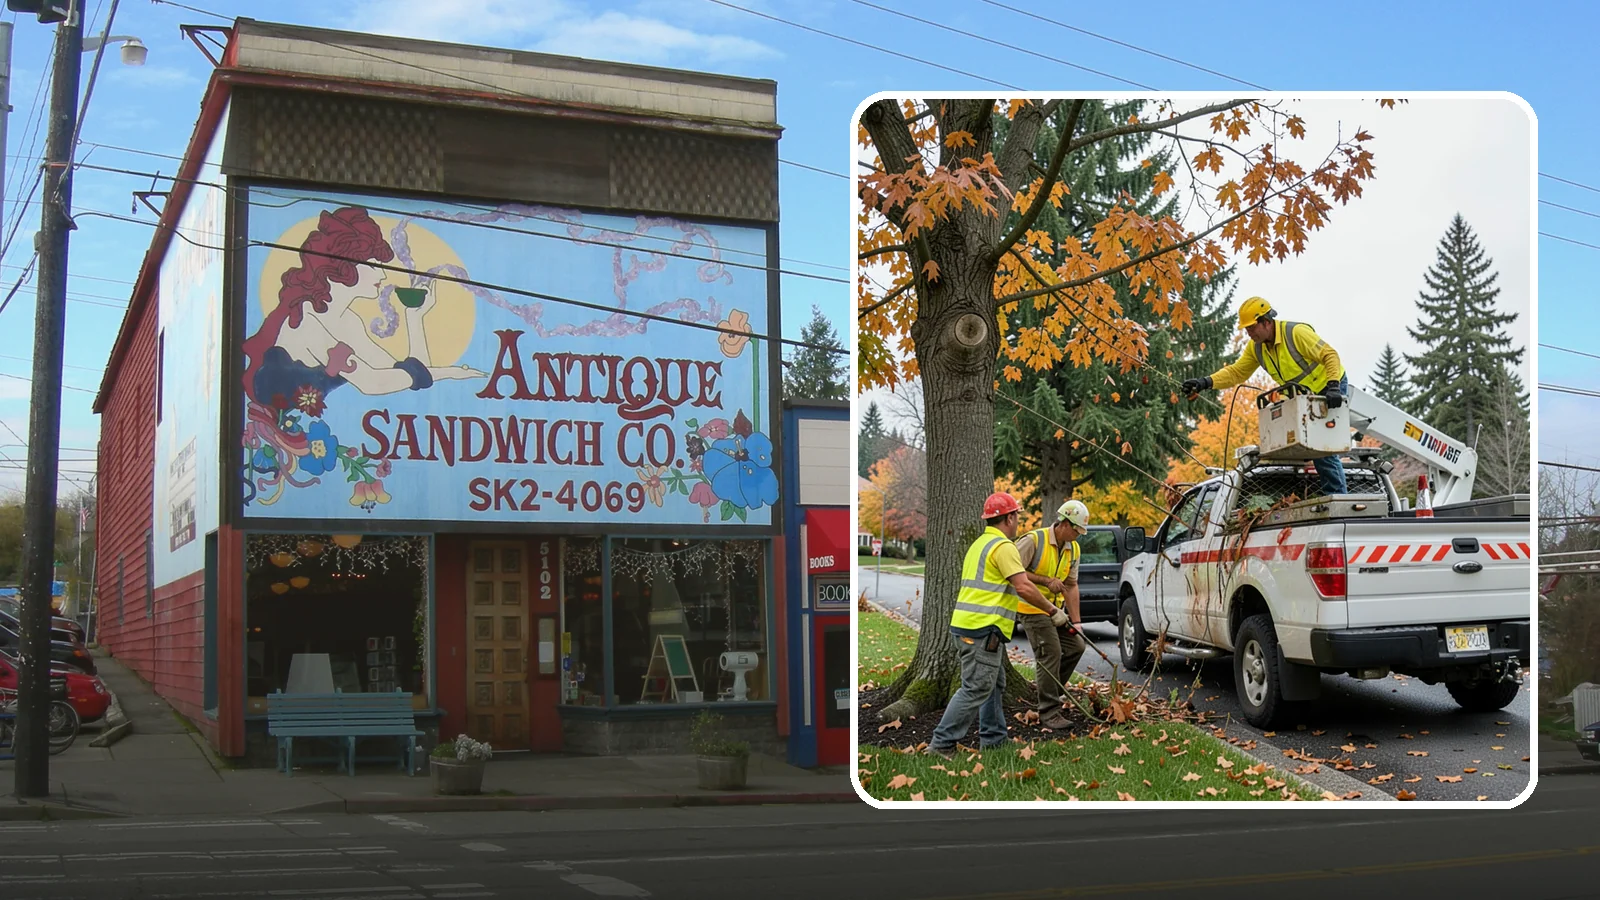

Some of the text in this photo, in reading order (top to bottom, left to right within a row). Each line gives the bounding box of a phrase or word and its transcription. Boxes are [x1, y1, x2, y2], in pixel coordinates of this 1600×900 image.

[477, 330, 724, 420] ANTIQUE
[361, 408, 686, 470] SANDWICH CO.
[468, 477, 646, 513] SK2-4069
[540, 541, 552, 600] 5102
[809, 555, 835, 569] BOOKS
